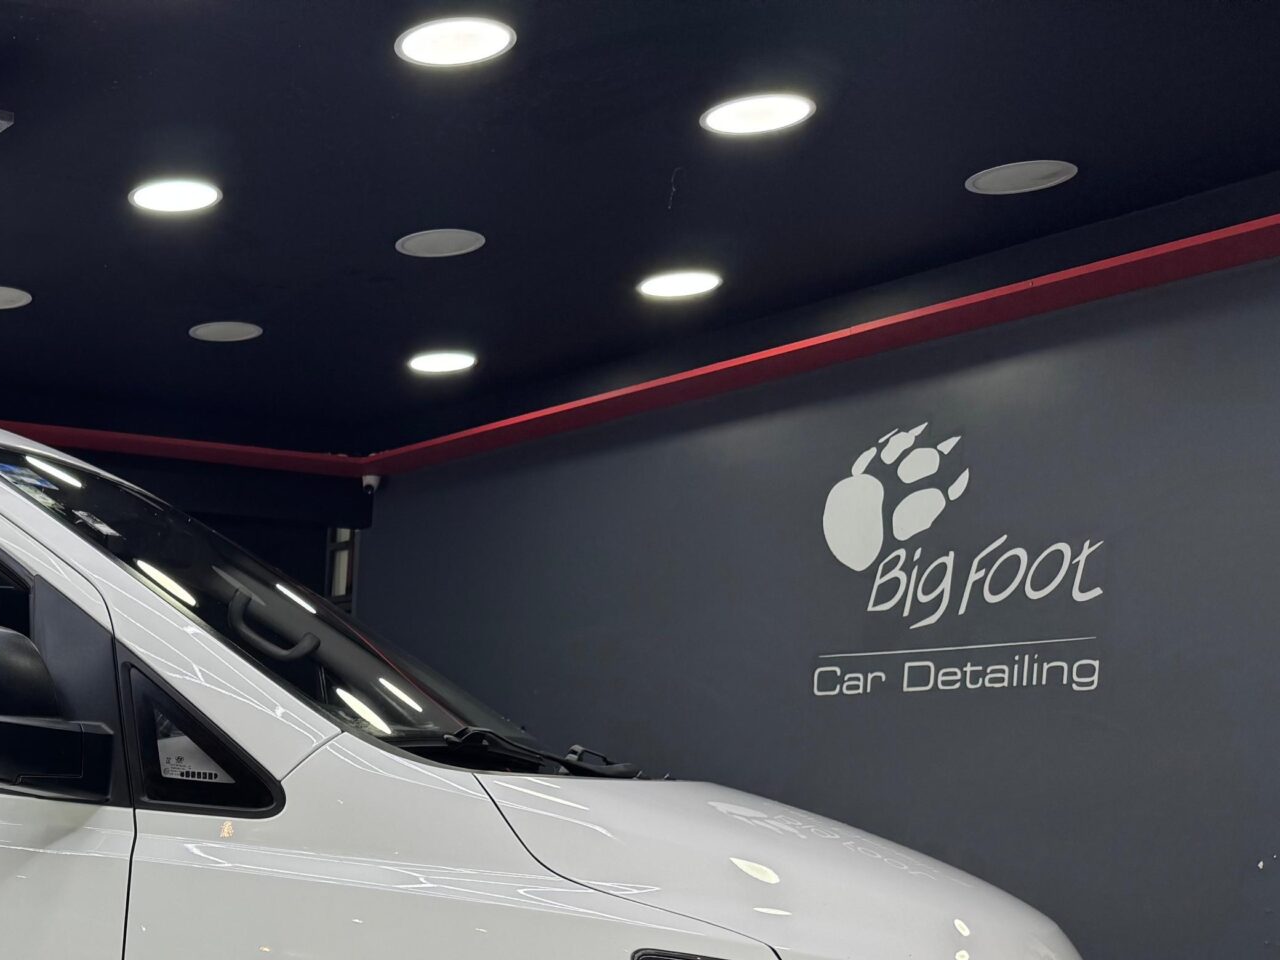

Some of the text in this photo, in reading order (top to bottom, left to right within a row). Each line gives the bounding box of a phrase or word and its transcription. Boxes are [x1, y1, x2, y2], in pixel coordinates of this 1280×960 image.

[867, 547, 954, 629] Big
[813, 653, 1100, 696] Car Detailing
